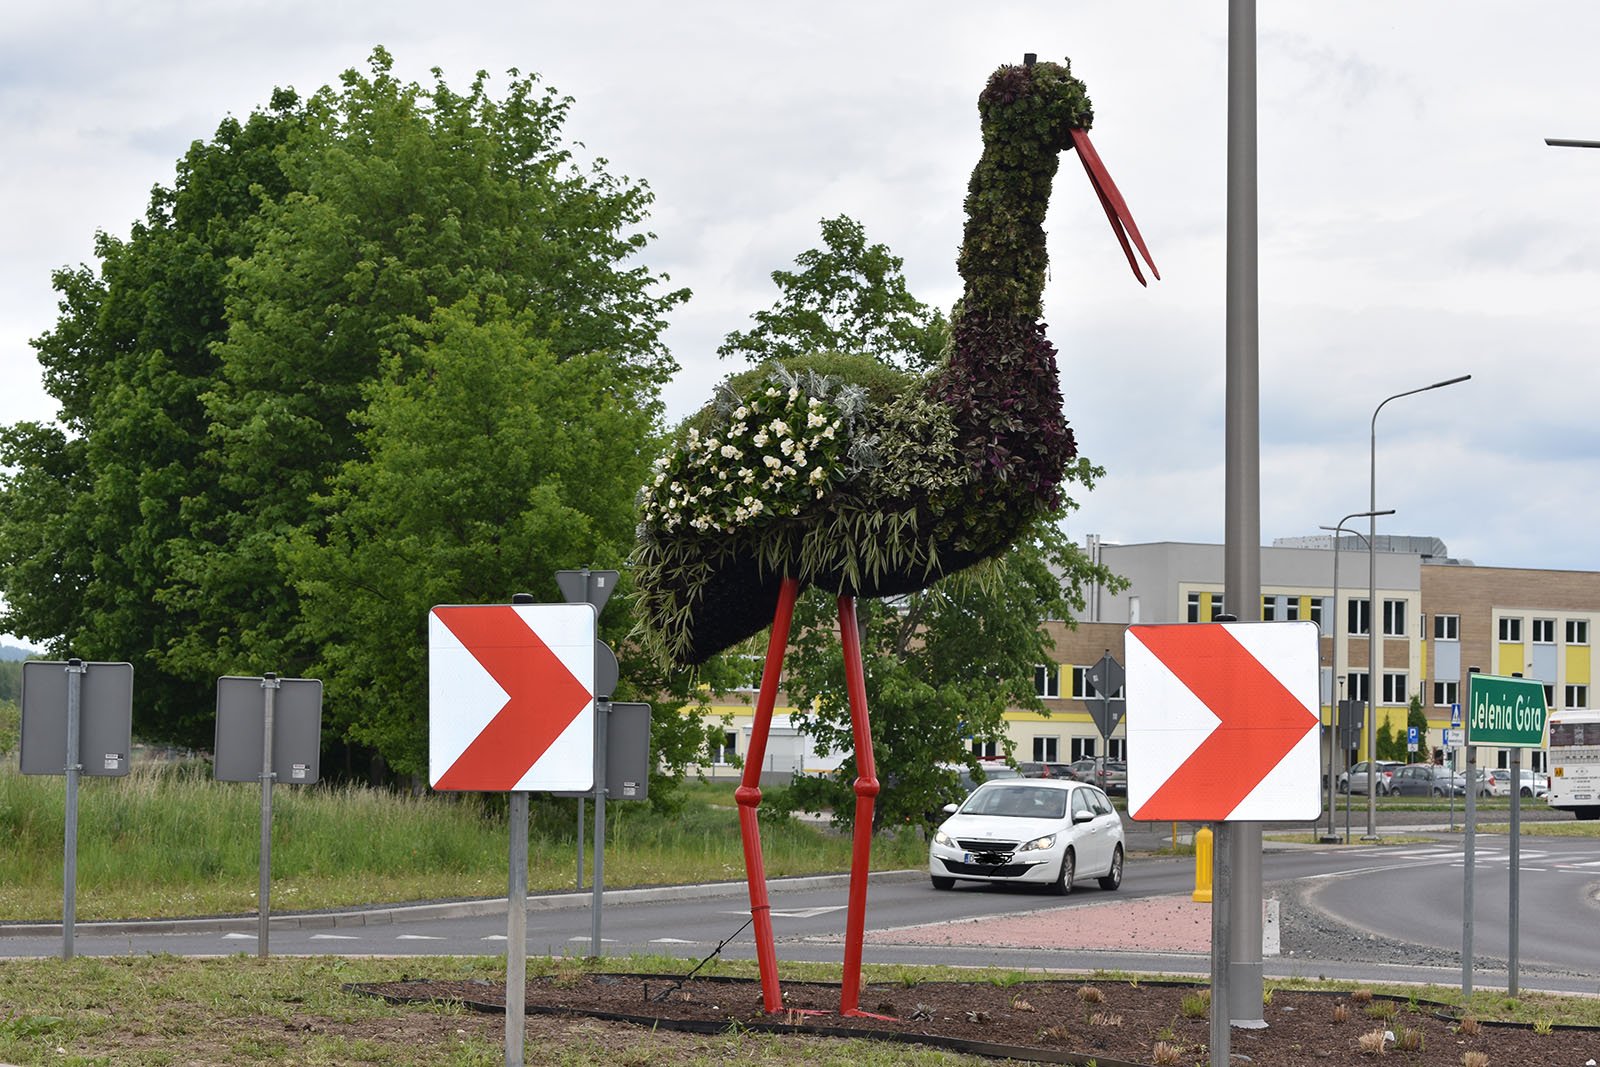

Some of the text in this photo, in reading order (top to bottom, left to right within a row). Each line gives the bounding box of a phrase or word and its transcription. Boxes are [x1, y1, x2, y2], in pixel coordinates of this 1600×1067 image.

[1472, 691, 1541, 732] Jelenia Góra
[1410, 728, 1417, 740] P
